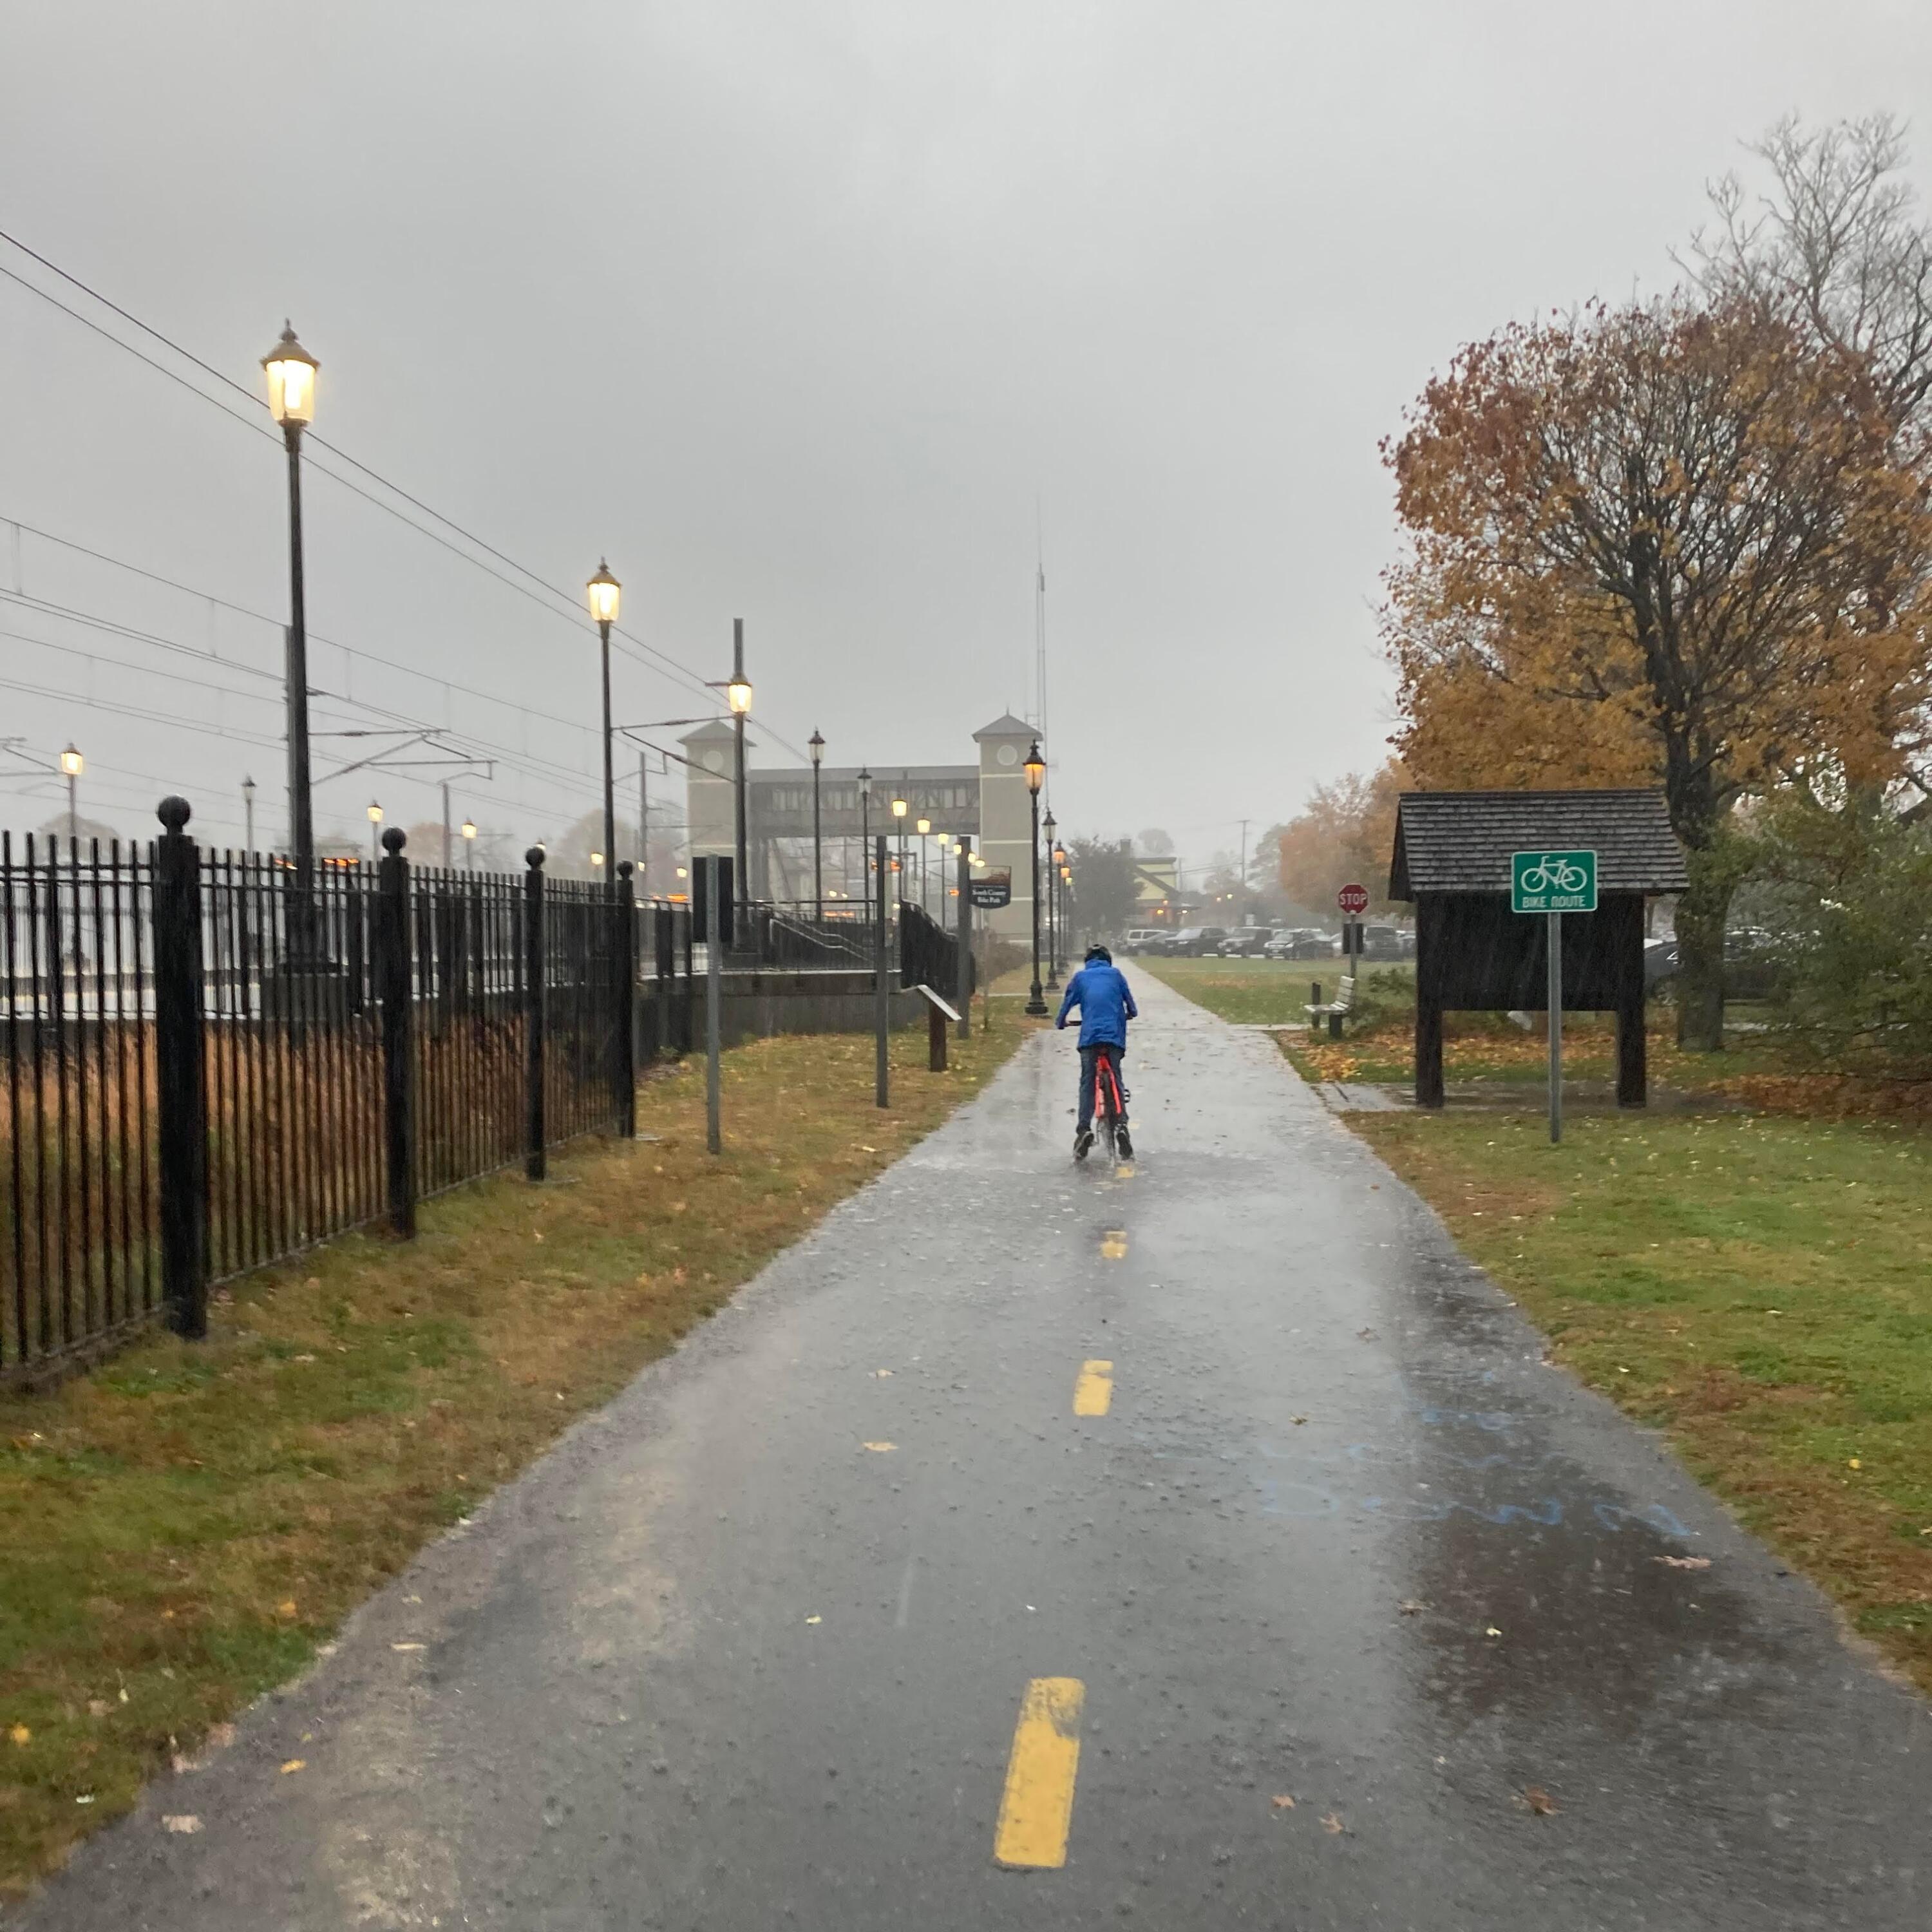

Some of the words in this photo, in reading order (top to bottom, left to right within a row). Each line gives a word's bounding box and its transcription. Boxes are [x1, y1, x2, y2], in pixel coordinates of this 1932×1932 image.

[1340, 893, 1367, 905] STOP
[1522, 896, 1548, 908] BIKE
[1551, 895, 1586, 907] ROUTE
